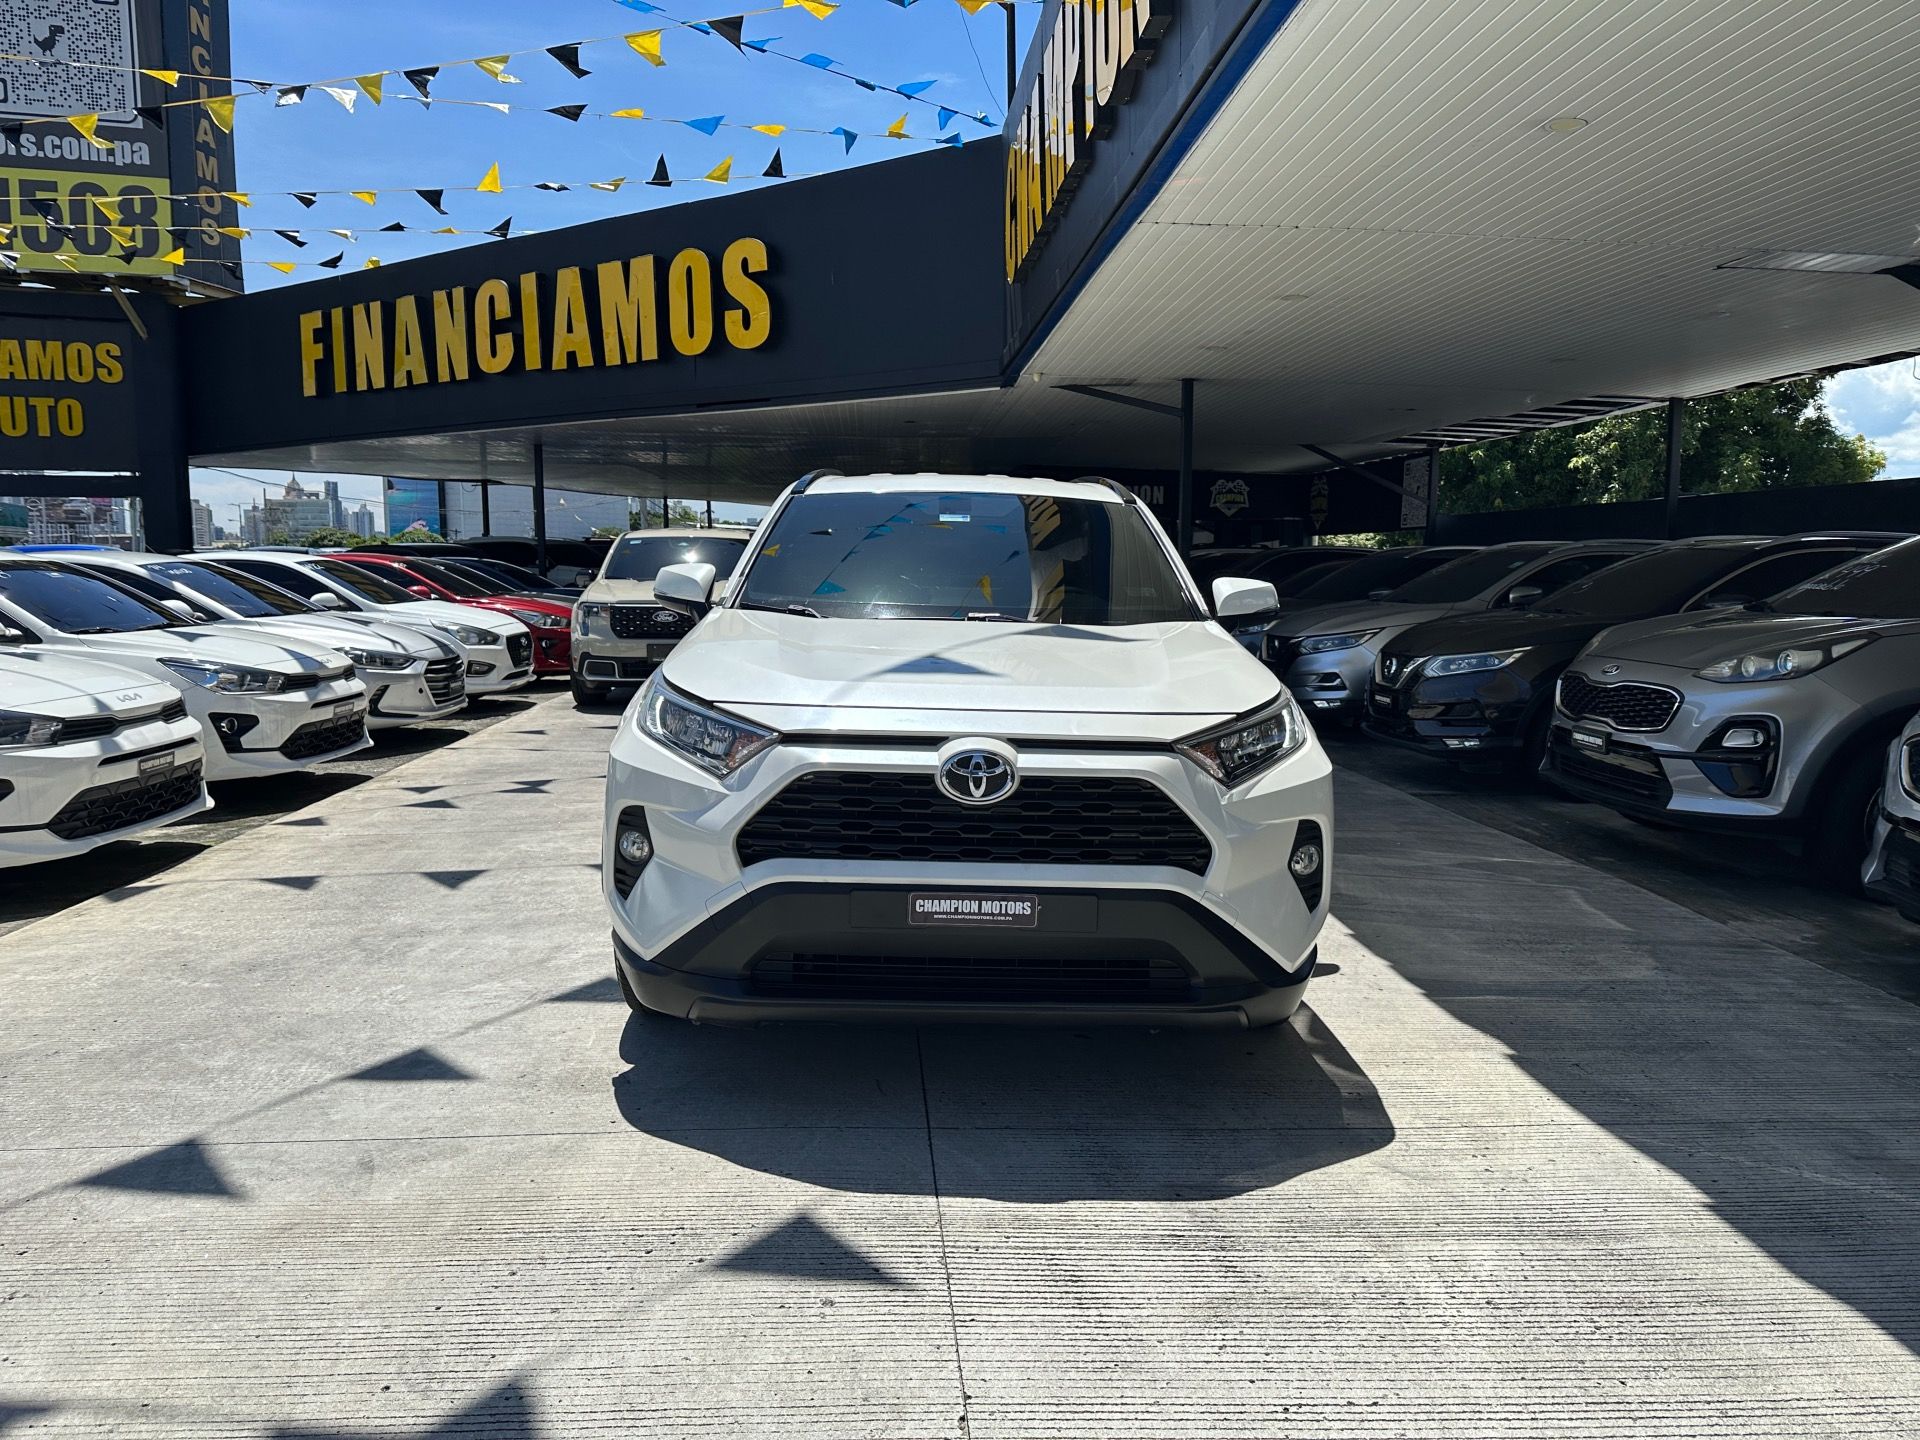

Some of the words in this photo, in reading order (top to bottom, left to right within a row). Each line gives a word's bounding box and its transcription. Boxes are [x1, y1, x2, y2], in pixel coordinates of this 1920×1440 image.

[190, 0, 222, 246] NCIAMOS
[1005, 0, 1151, 285] CHAMPIO
[0, 339, 124, 384] AMOS
[300, 237, 771, 398] FINANCIAMOS
[0, 396, 84, 437] UTO
[915, 899, 979, 913] CHAMPION
[981, 901, 1032, 915] MOTORS
